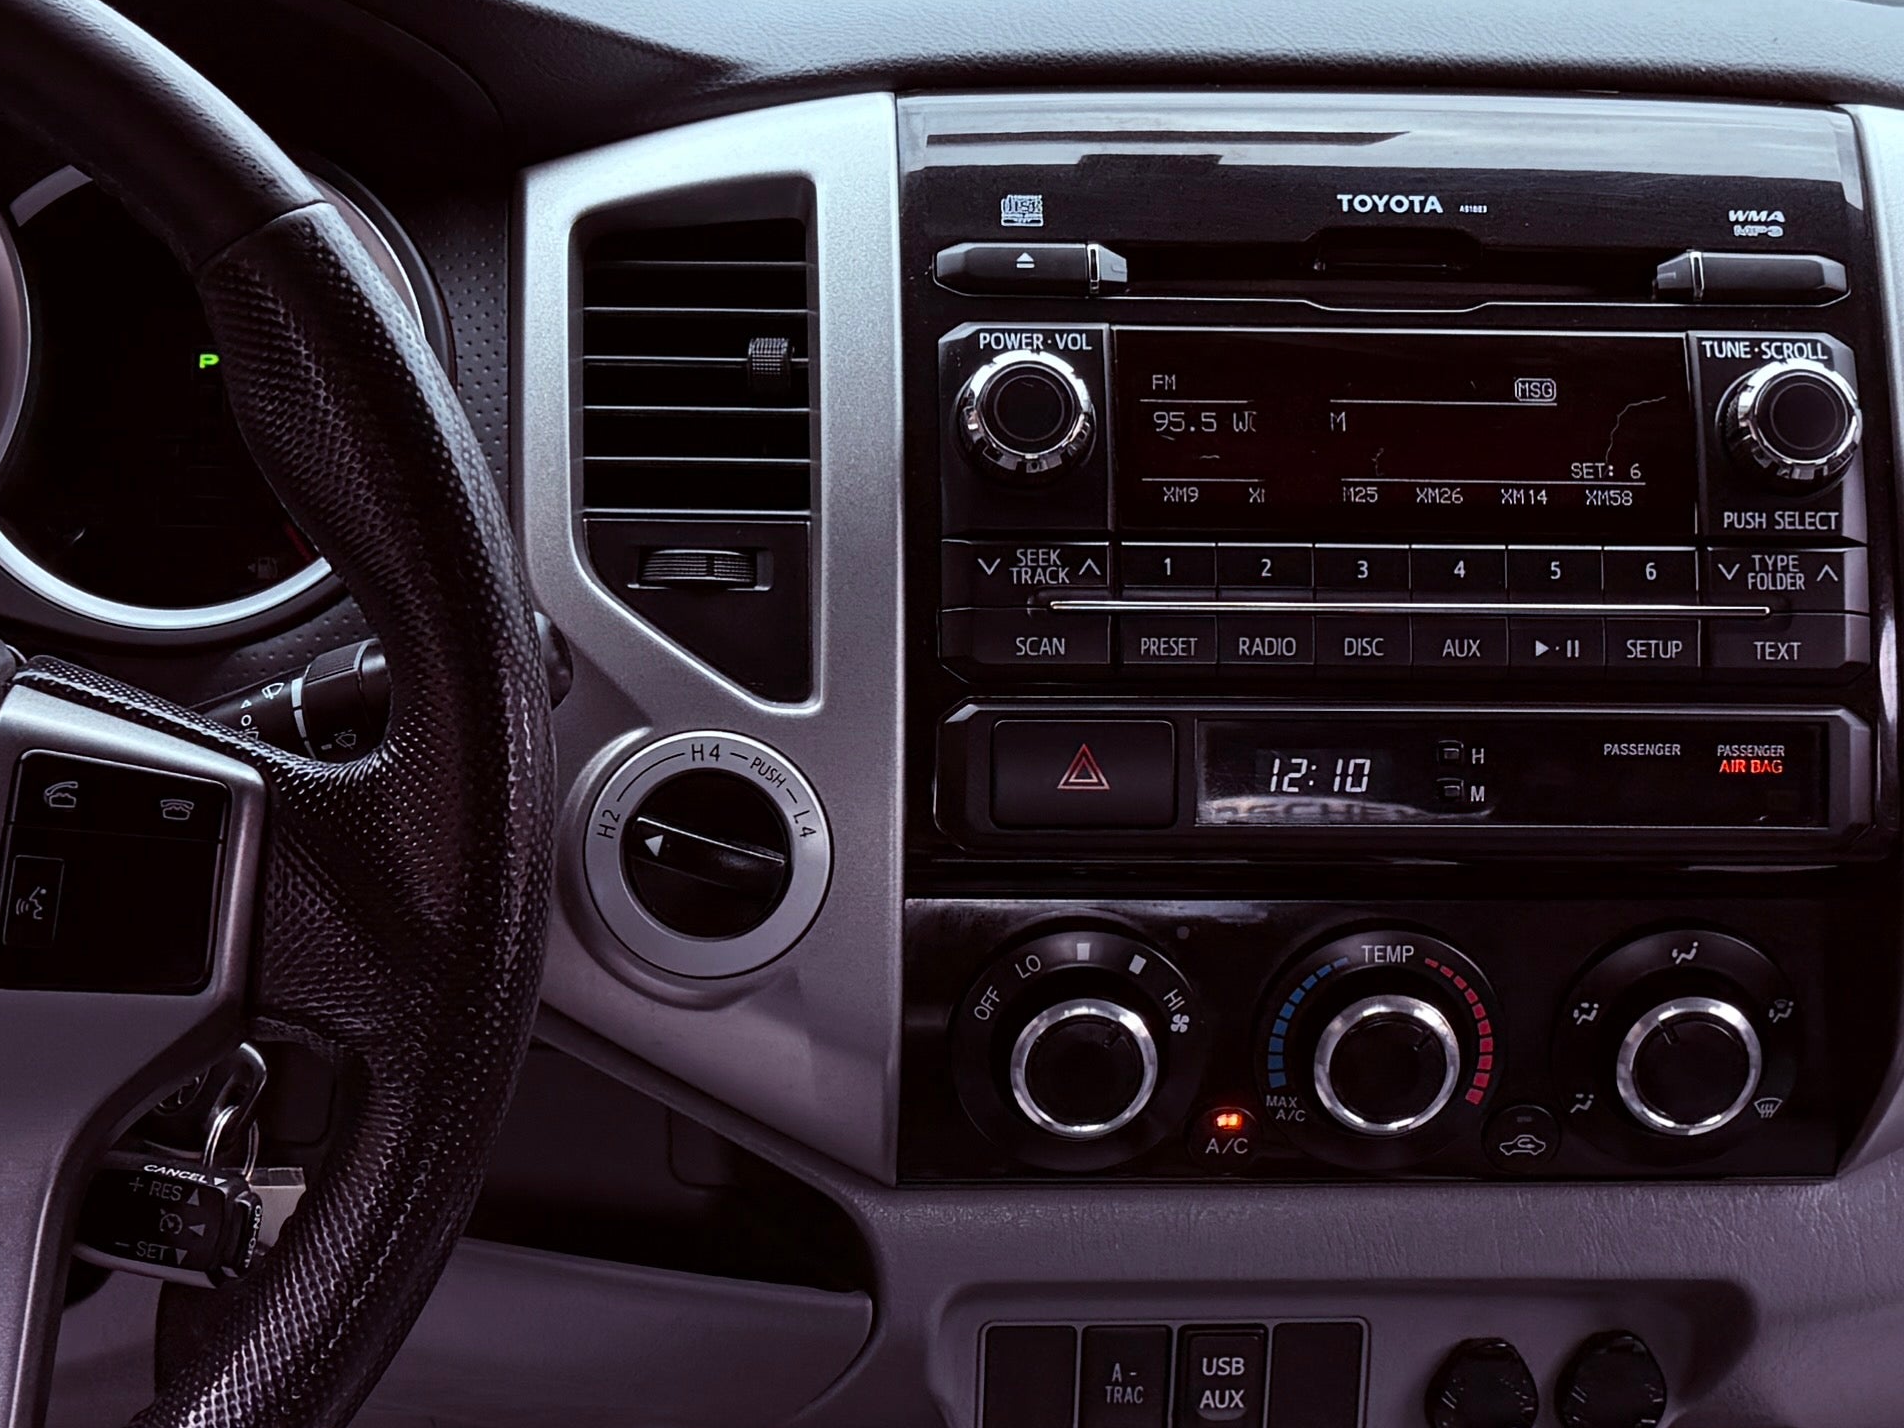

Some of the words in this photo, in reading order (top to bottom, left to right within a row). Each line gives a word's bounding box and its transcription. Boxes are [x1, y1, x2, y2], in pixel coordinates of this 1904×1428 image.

[1337, 193, 1444, 214] TOYOTA
[1728, 209, 1786, 223] WMA
[1732, 224, 1785, 239] MP3
[200, 354, 219, 368] P
[1152, 375, 1176, 391] FM
[1518, 382, 1553, 399] MSG
[1153, 411, 1217, 434] 95.5
[1570, 463, 1614, 480] SET:
[1630, 463, 1641, 480] 6
[1163, 486, 1199, 504] XM9
[1416, 486, 1464, 504] XM26
[1501, 488, 1548, 506] XM14
[1585, 488, 1633, 506] XM58
[1723, 512, 1767, 530] PUSH
[1774, 512, 1839, 530] SELECT
[1016, 548, 1061, 567] SEEK
[1751, 554, 1799, 573] TYPE
[1009, 567, 1070, 585] TRACK
[1163, 558, 1172, 576] 1
[1261, 559, 1272, 577] 2
[1357, 560, 1368, 578] 3
[1453, 560, 1465, 578] 4
[1550, 561, 1561, 579] 5
[1645, 562, 1657, 581] 6
[1747, 572, 1805, 591] FOLDER
[1015, 636, 1065, 657] SCAN
[1140, 637, 1198, 657] PRESET
[1238, 637, 1296, 657] RADIO
[1343, 637, 1384, 657] DISC
[1442, 638, 1481, 658] AUX
[1626, 639, 1682, 659] SETUP
[1753, 642, 1801, 661] TEXT
[1471, 748, 1485, 765] H
[1603, 742, 1681, 757] PASSENGER
[1717, 744, 1785, 757] PASSENGER
[749, 757, 787, 789] PUSH
[1269, 757, 1372, 794] 12:10
[1719, 759, 1746, 774] AIR
[1750, 759, 1783, 774] BAG
[1471, 785, 1485, 803] M
[1361, 945, 1415, 964] TEMP
[1014, 954, 1042, 980] LO
[973, 985, 1001, 1022] OFF
[1163, 988, 1185, 1012] HI
[1265, 1094, 1298, 1110] MAX
[1275, 1108, 1307, 1123] A/C
[1205, 1137, 1249, 1155] A/C
[143, 1163, 209, 1185] CANCEL
[149, 1180, 183, 1202] RES
[136, 1240, 170, 1261] SET
[1202, 1357, 1245, 1377] USB
[1105, 1385, 1144, 1405] TRAC
[1200, 1389, 1245, 1410] AUX
